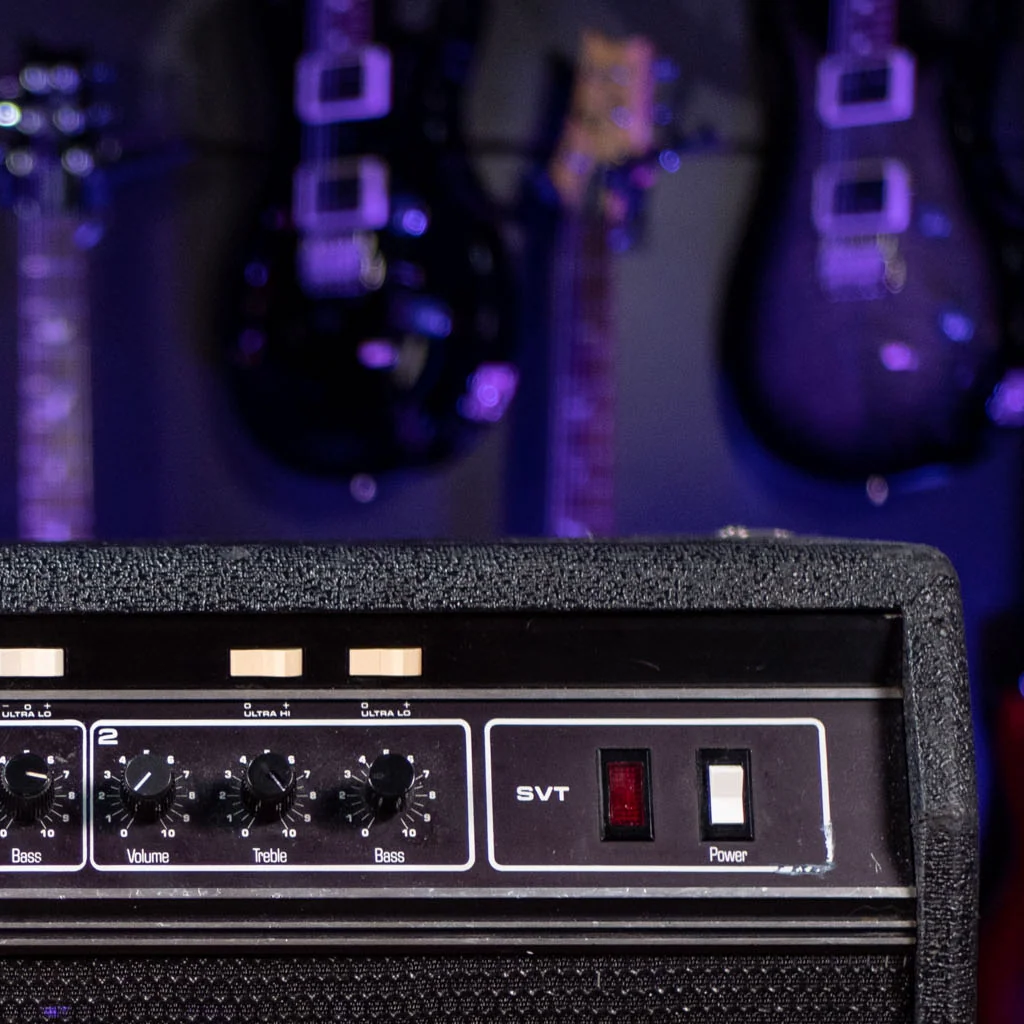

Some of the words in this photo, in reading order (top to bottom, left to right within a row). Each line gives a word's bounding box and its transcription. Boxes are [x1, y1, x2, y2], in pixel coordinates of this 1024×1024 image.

[1, 710, 35, 718] ULTRA
[37, 710, 52, 718] LO
[243, 710, 278, 718] ULTRA
[360, 709, 395, 718] ULTRA
[396, 709, 412, 717] LO
[97, 728, 119, 745] 2
[46, 755, 55, 765] 6
[118, 755, 127, 765] 4
[166, 755, 175, 765] 6
[239, 755, 247, 765] 4
[287, 754, 296, 765] 6
[358, 755, 367, 764] 4
[62, 770, 70, 779] 7
[103, 770, 112, 780] 3
[182, 770, 190, 779] 7
[224, 769, 232, 779] 3
[303, 769, 311, 779] 7
[344, 769, 352, 779] 3
[422, 769, 430, 779] 7
[68, 791, 76, 800] 8
[98, 791, 106, 800] 2
[188, 791, 196, 800] 8
[219, 791, 226, 800] 2
[309, 790, 317, 800] 8
[338, 790, 346, 800] 2
[428, 790, 436, 800] 8
[516, 785, 570, 802] SVT
[62, 813, 70, 823] 9
[105, 814, 112, 823] 1
[182, 813, 190, 823] 9
[226, 813, 233, 823] 1
[303, 813, 312, 823] 9
[345, 813, 353, 823] 1
[423, 813, 431, 823] 9
[0, 829, 8, 839] 0
[40, 829, 55, 838] 10
[120, 828, 128, 838] 0
[160, 827, 176, 838] 10
[241, 828, 250, 838] 0
[281, 827, 297, 838] 10
[361, 828, 370, 838] 0
[401, 827, 417, 838] 10
[11, 847, 42, 864] Bass
[126, 848, 170, 864] Volume
[252, 847, 288, 864] Treble
[374, 847, 406, 864] Bass
[709, 846, 748, 863] Power
